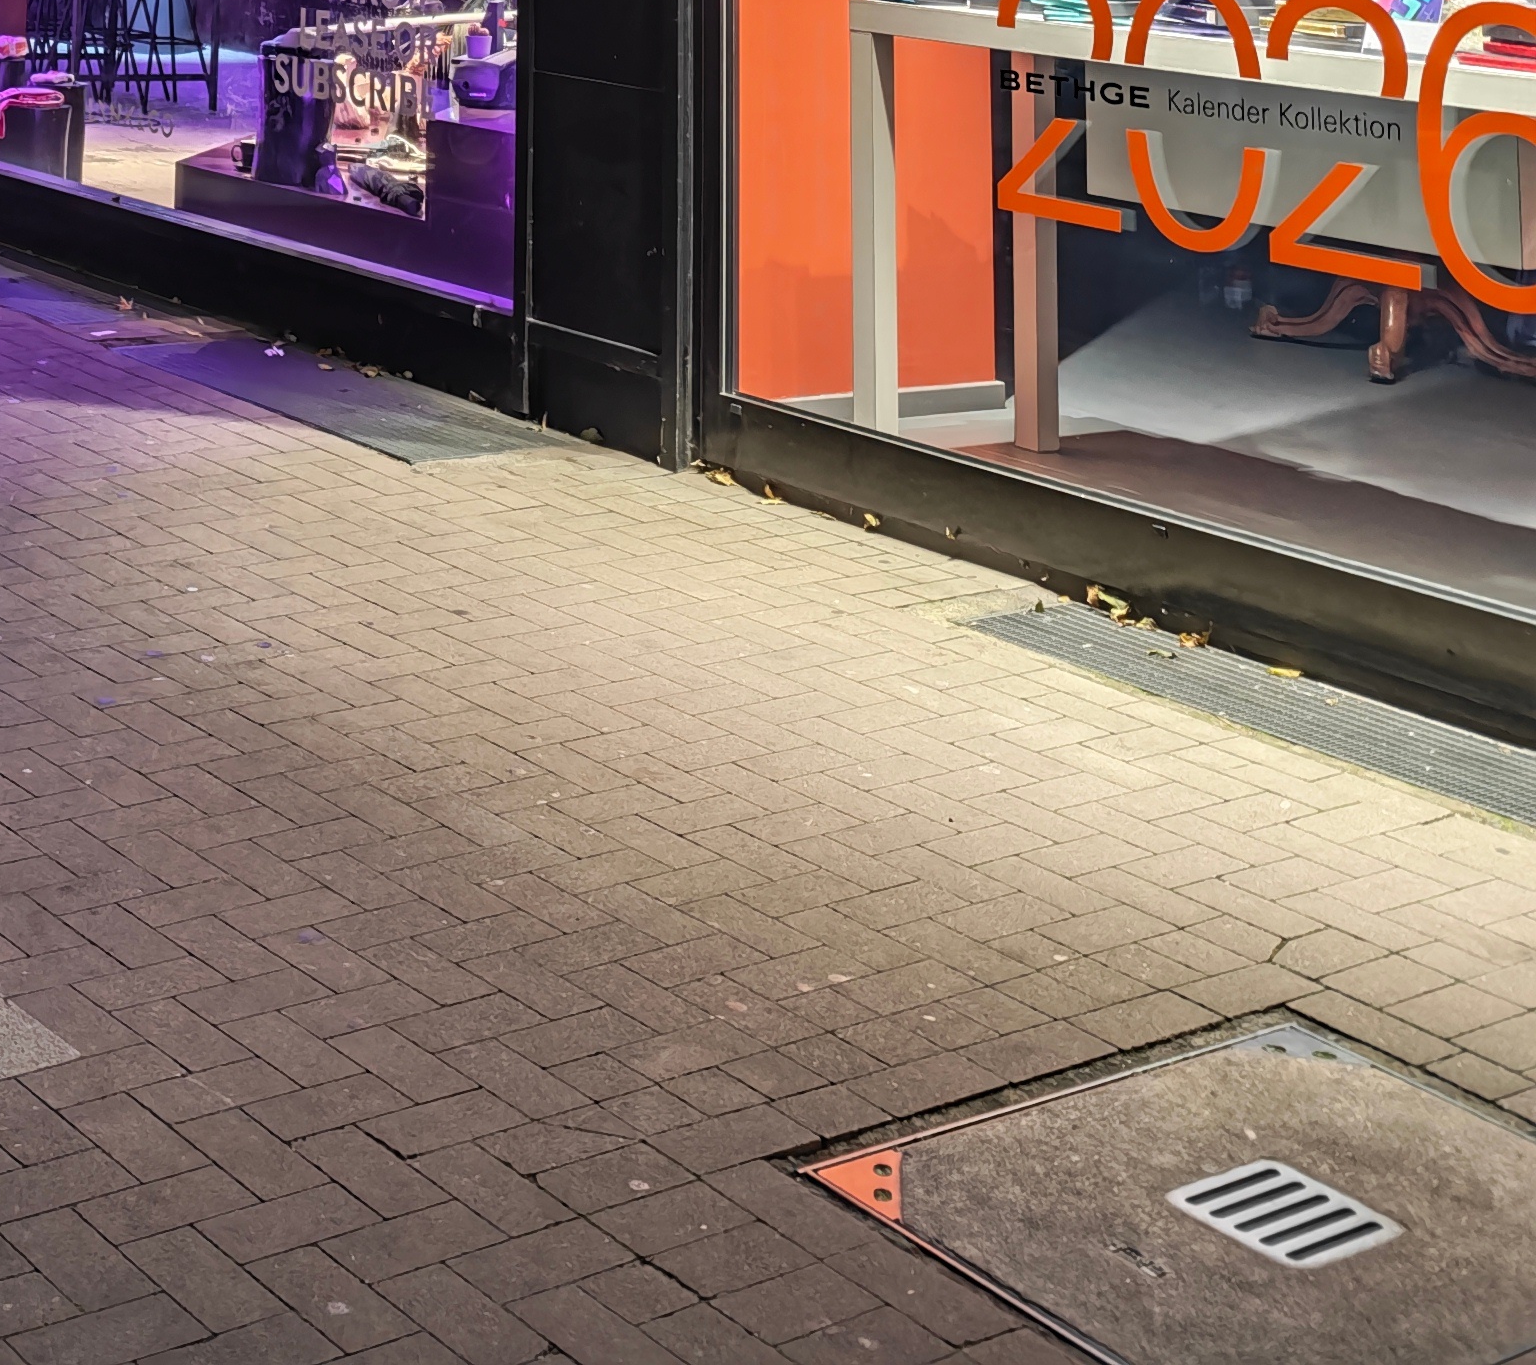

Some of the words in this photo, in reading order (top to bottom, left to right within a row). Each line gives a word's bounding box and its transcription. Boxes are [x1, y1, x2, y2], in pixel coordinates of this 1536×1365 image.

[300, 7, 387, 57] LEASE
[272, 52, 436, 121] SUBSCRIBE
[999, 68, 1151, 110] BETHGE
[1167, 88, 1270, 125] Kalender
[1279, 102, 1402, 143] Kollektion
